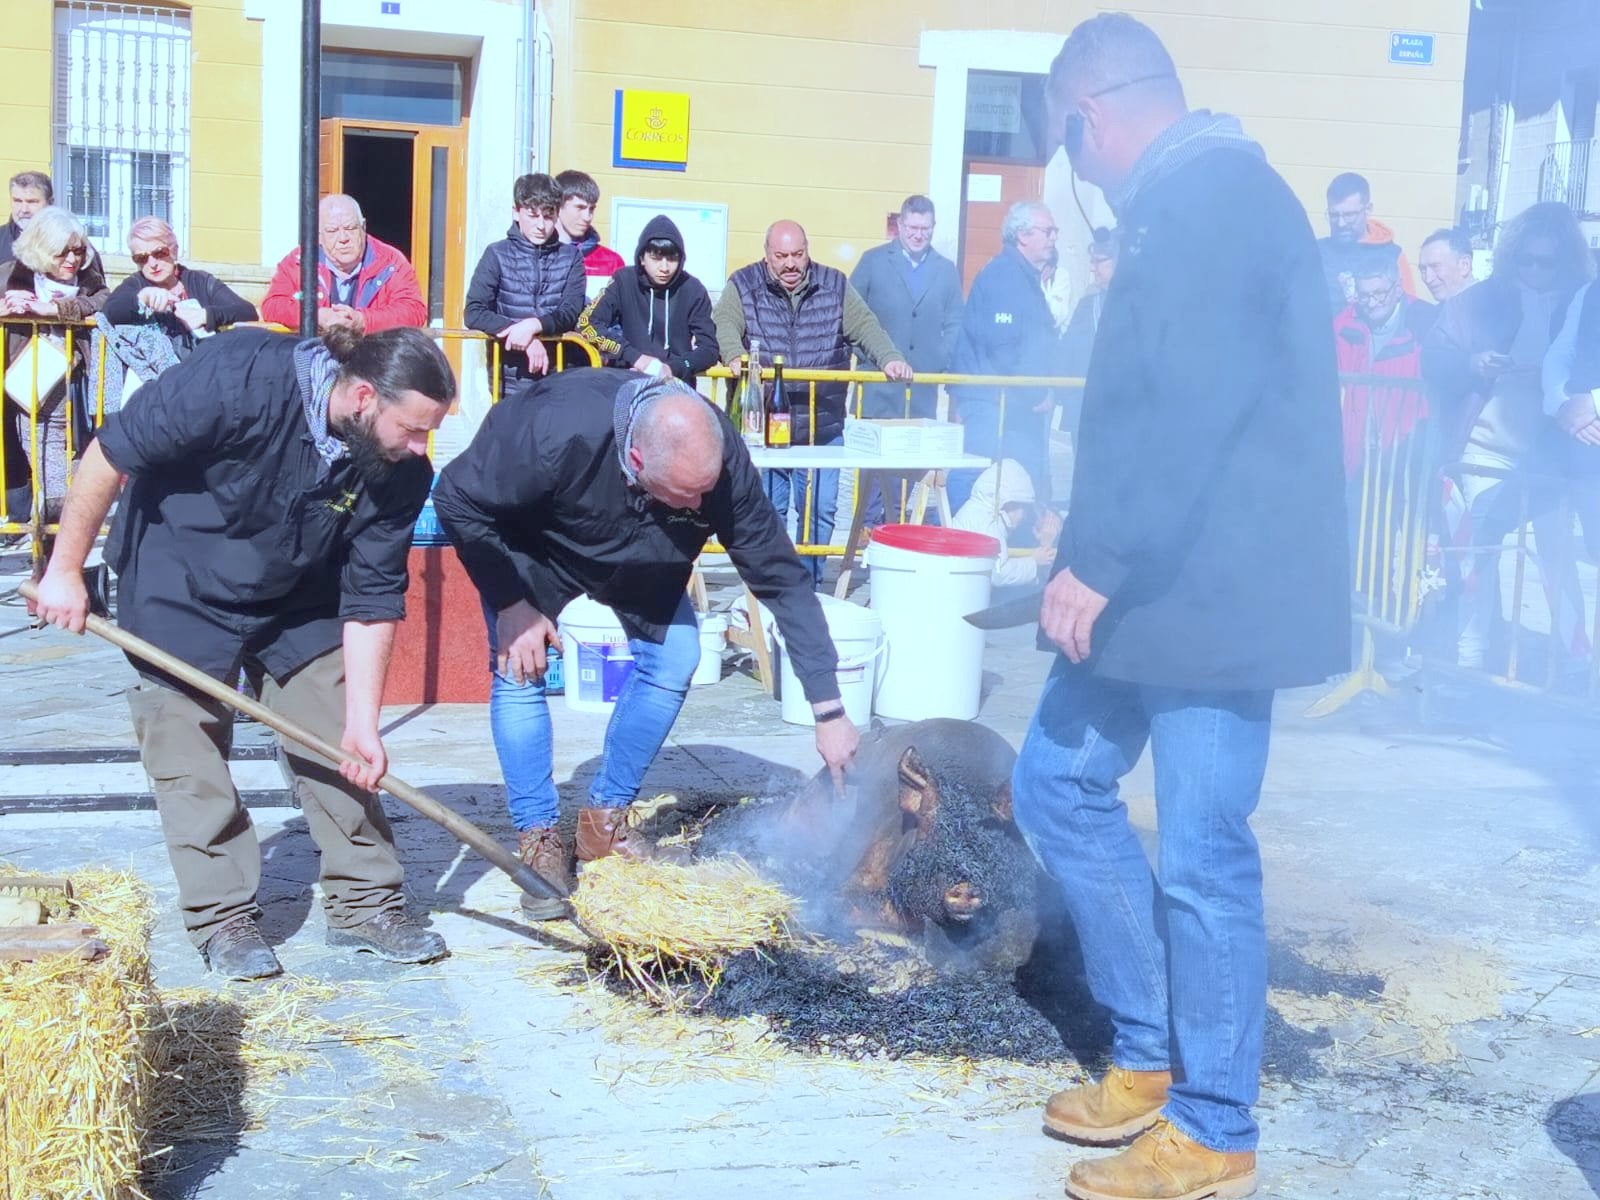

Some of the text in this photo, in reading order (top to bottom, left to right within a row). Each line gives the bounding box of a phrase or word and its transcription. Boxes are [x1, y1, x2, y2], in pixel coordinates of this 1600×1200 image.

[388, 4, 393, 13] 1
[1401, 38, 1424, 47] PLAZA
[626, 128, 684, 143] CORREOS
[995, 312, 1012, 324] HH
